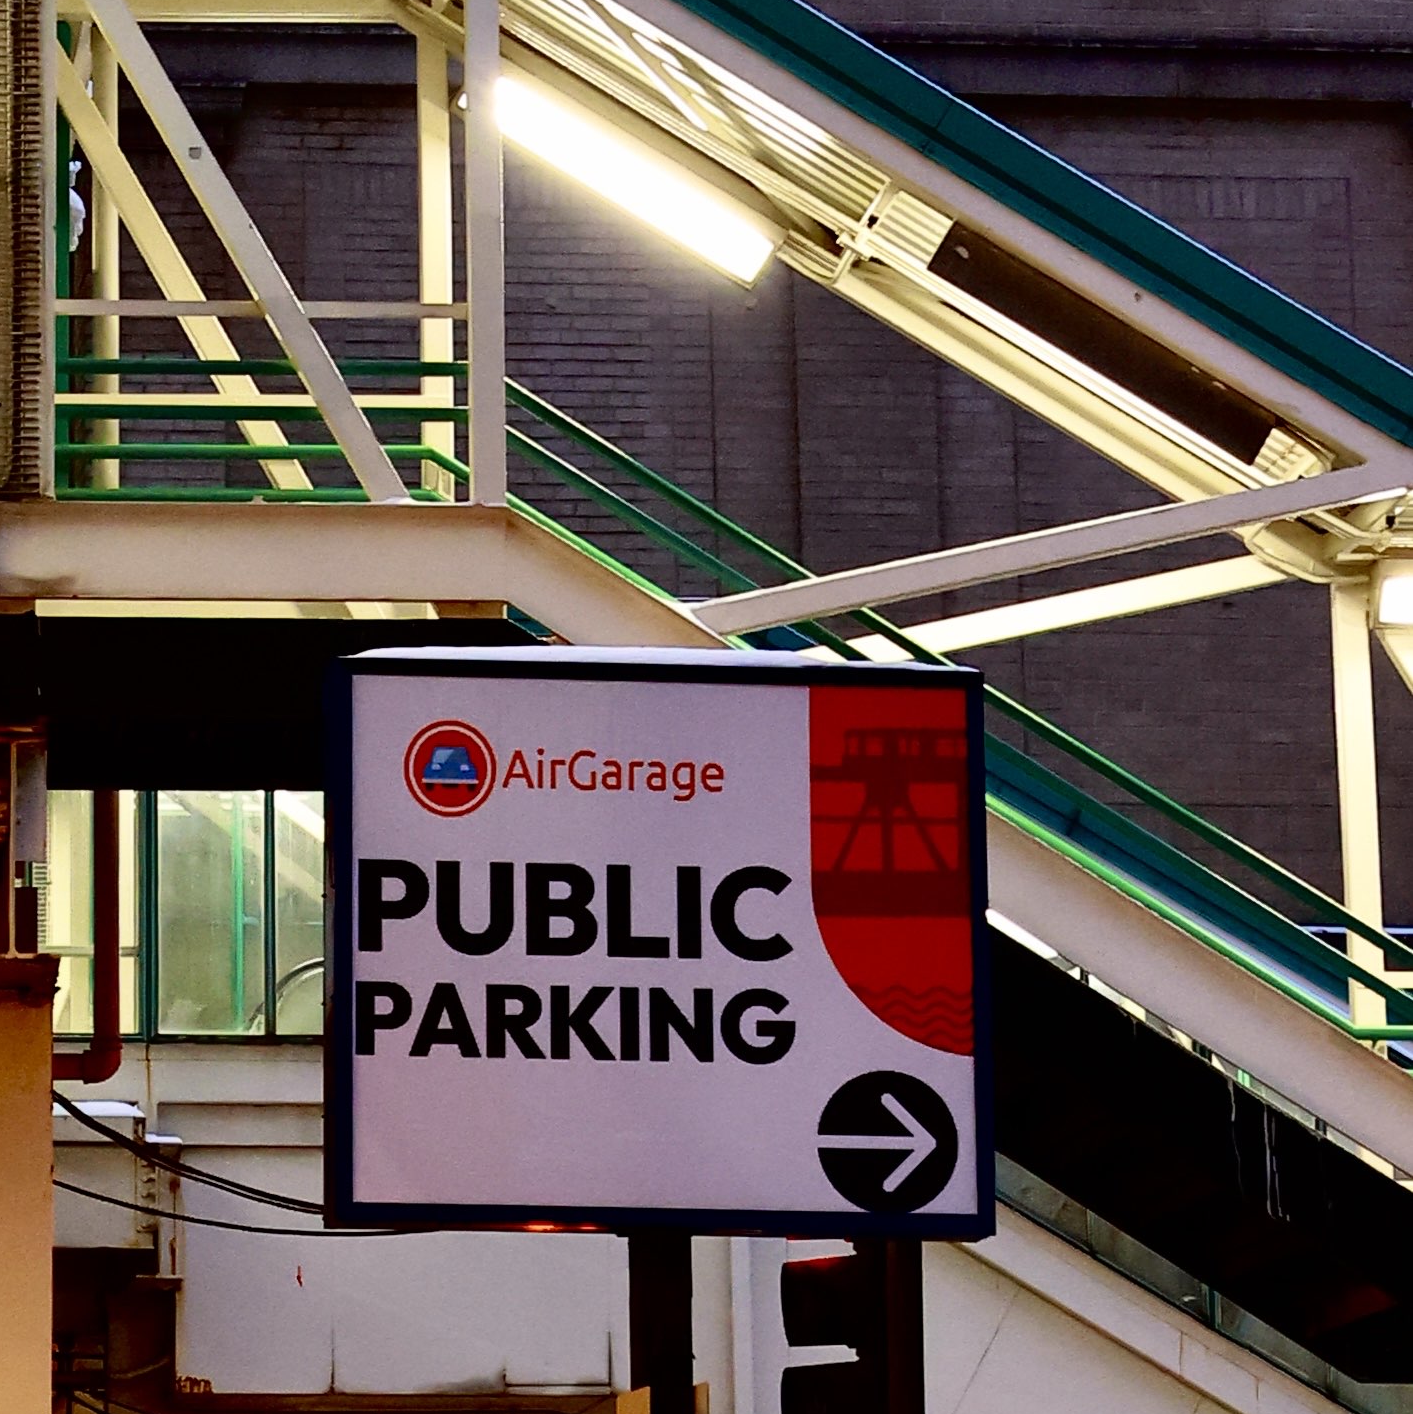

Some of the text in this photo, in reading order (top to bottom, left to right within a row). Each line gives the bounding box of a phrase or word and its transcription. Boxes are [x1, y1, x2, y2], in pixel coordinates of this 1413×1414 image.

[501, 748, 725, 802] AirGarage
[357, 858, 794, 962] PUBLIC
[355, 980, 796, 1065] PARKING
